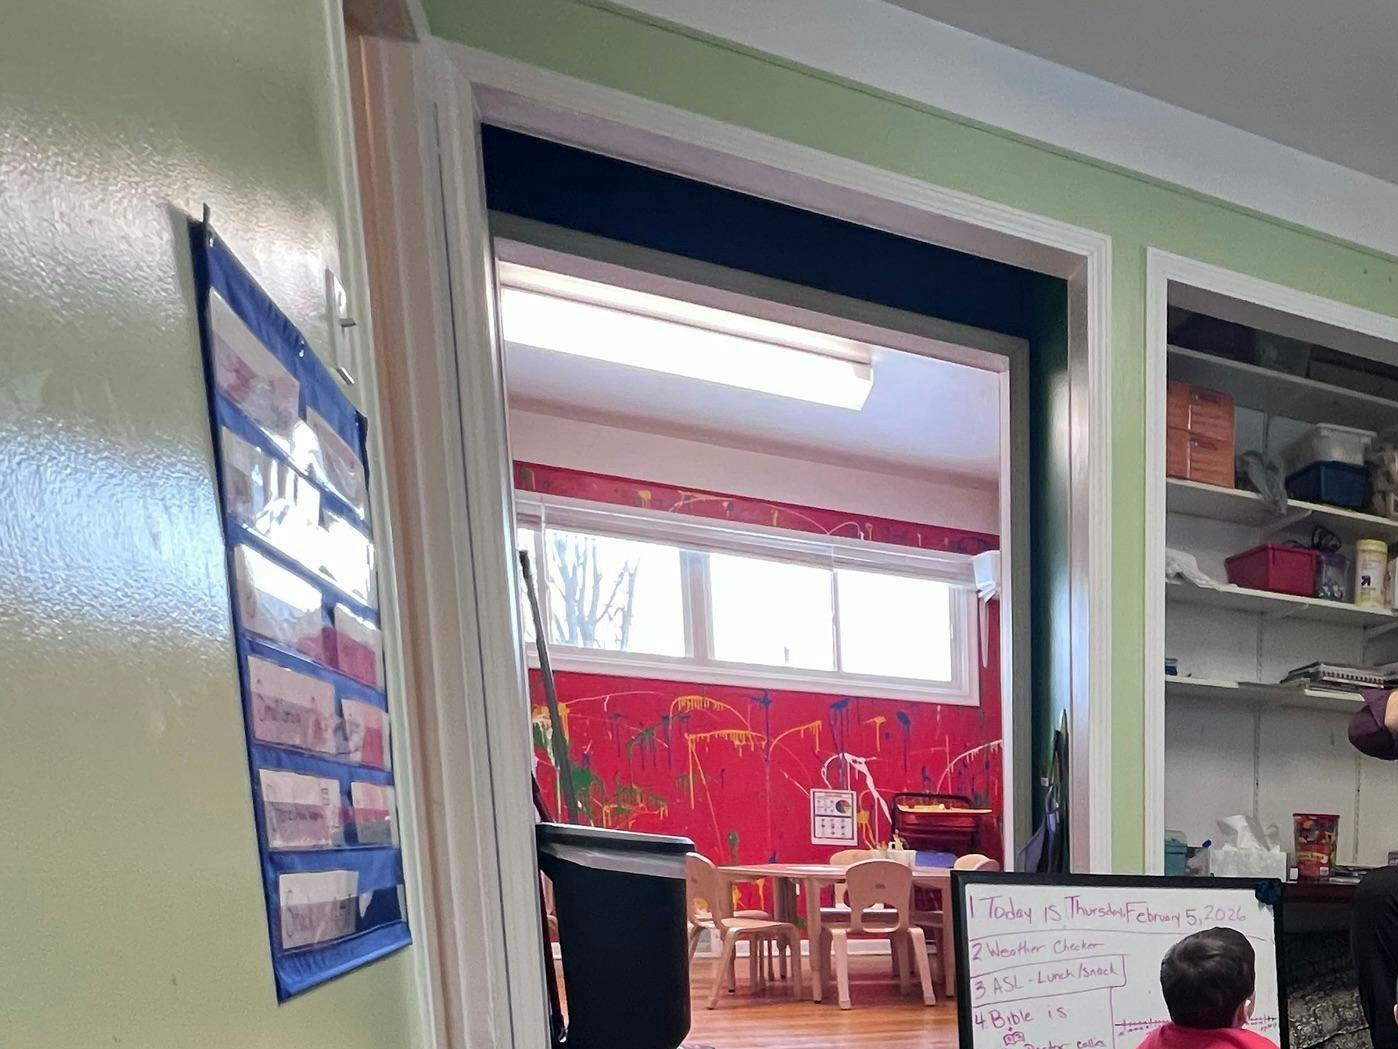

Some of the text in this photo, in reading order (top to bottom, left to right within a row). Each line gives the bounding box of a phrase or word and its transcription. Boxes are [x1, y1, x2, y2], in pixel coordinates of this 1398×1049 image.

[979, 895, 1033, 925] Today
[1126, 901, 1181, 928] February
[1203, 904, 1247, 922] 2026
[972, 938, 1105, 961] 2 Weather Checker
[993, 974, 1025, 995] ASL
[974, 1010, 986, 1029] 4
[989, 1009, 1034, 1029] Bible
